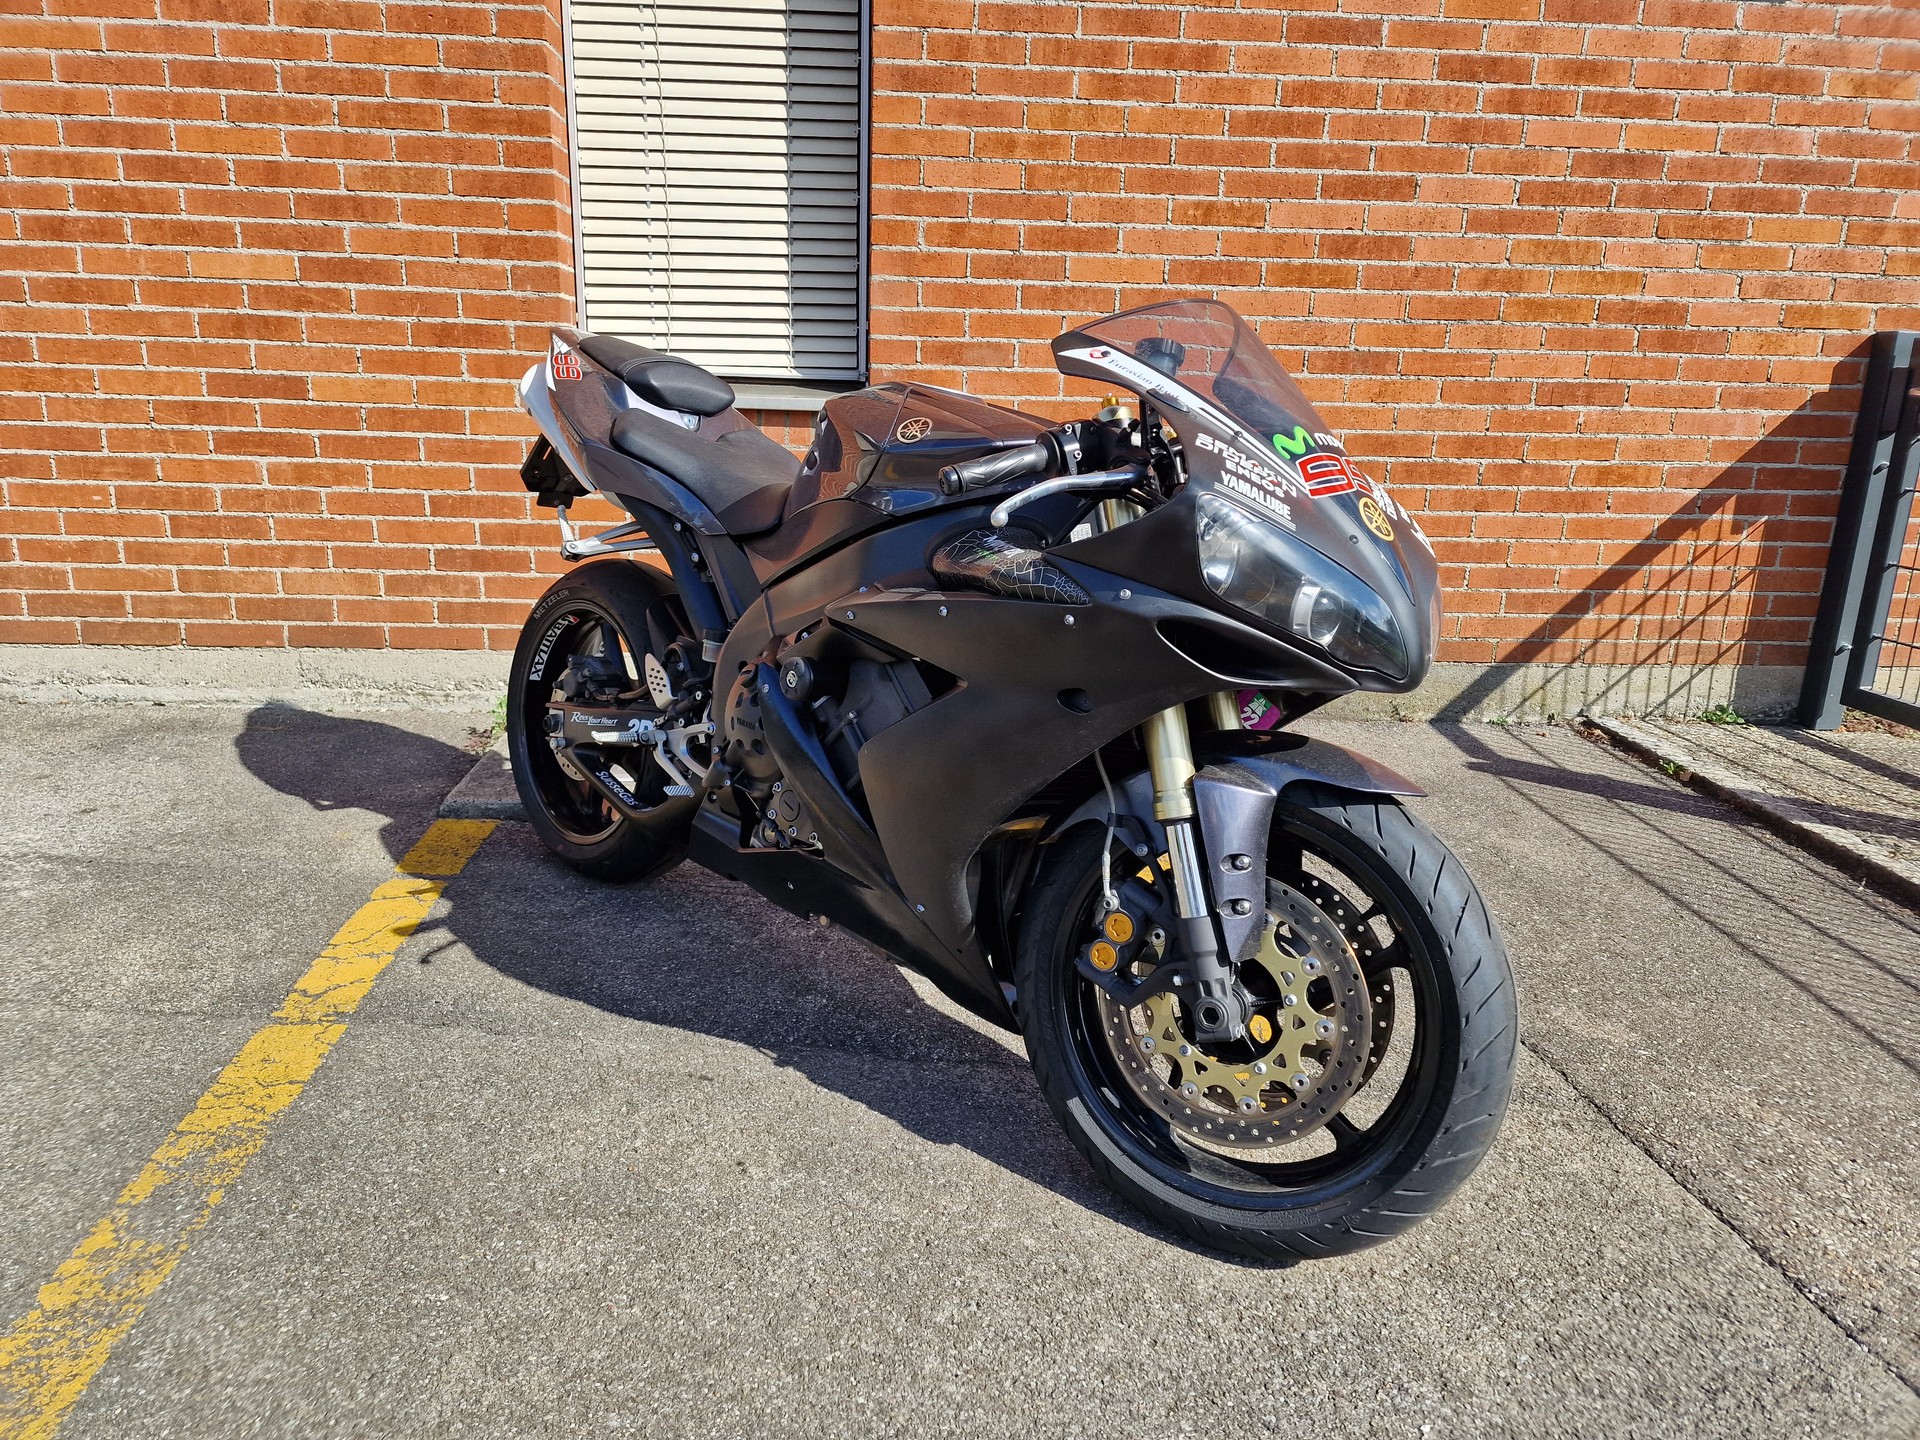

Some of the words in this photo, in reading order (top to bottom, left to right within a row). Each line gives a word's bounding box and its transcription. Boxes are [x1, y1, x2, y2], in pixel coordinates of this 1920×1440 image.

[1107, 358, 1153, 386] Eurasian
[1225, 459, 1285, 498] ENEOS
[1220, 470, 1292, 521] YAMALUBE
[533, 589, 570, 620] METZELER
[587, 715, 602, 726] Your
[600, 717, 618, 725] Heart
